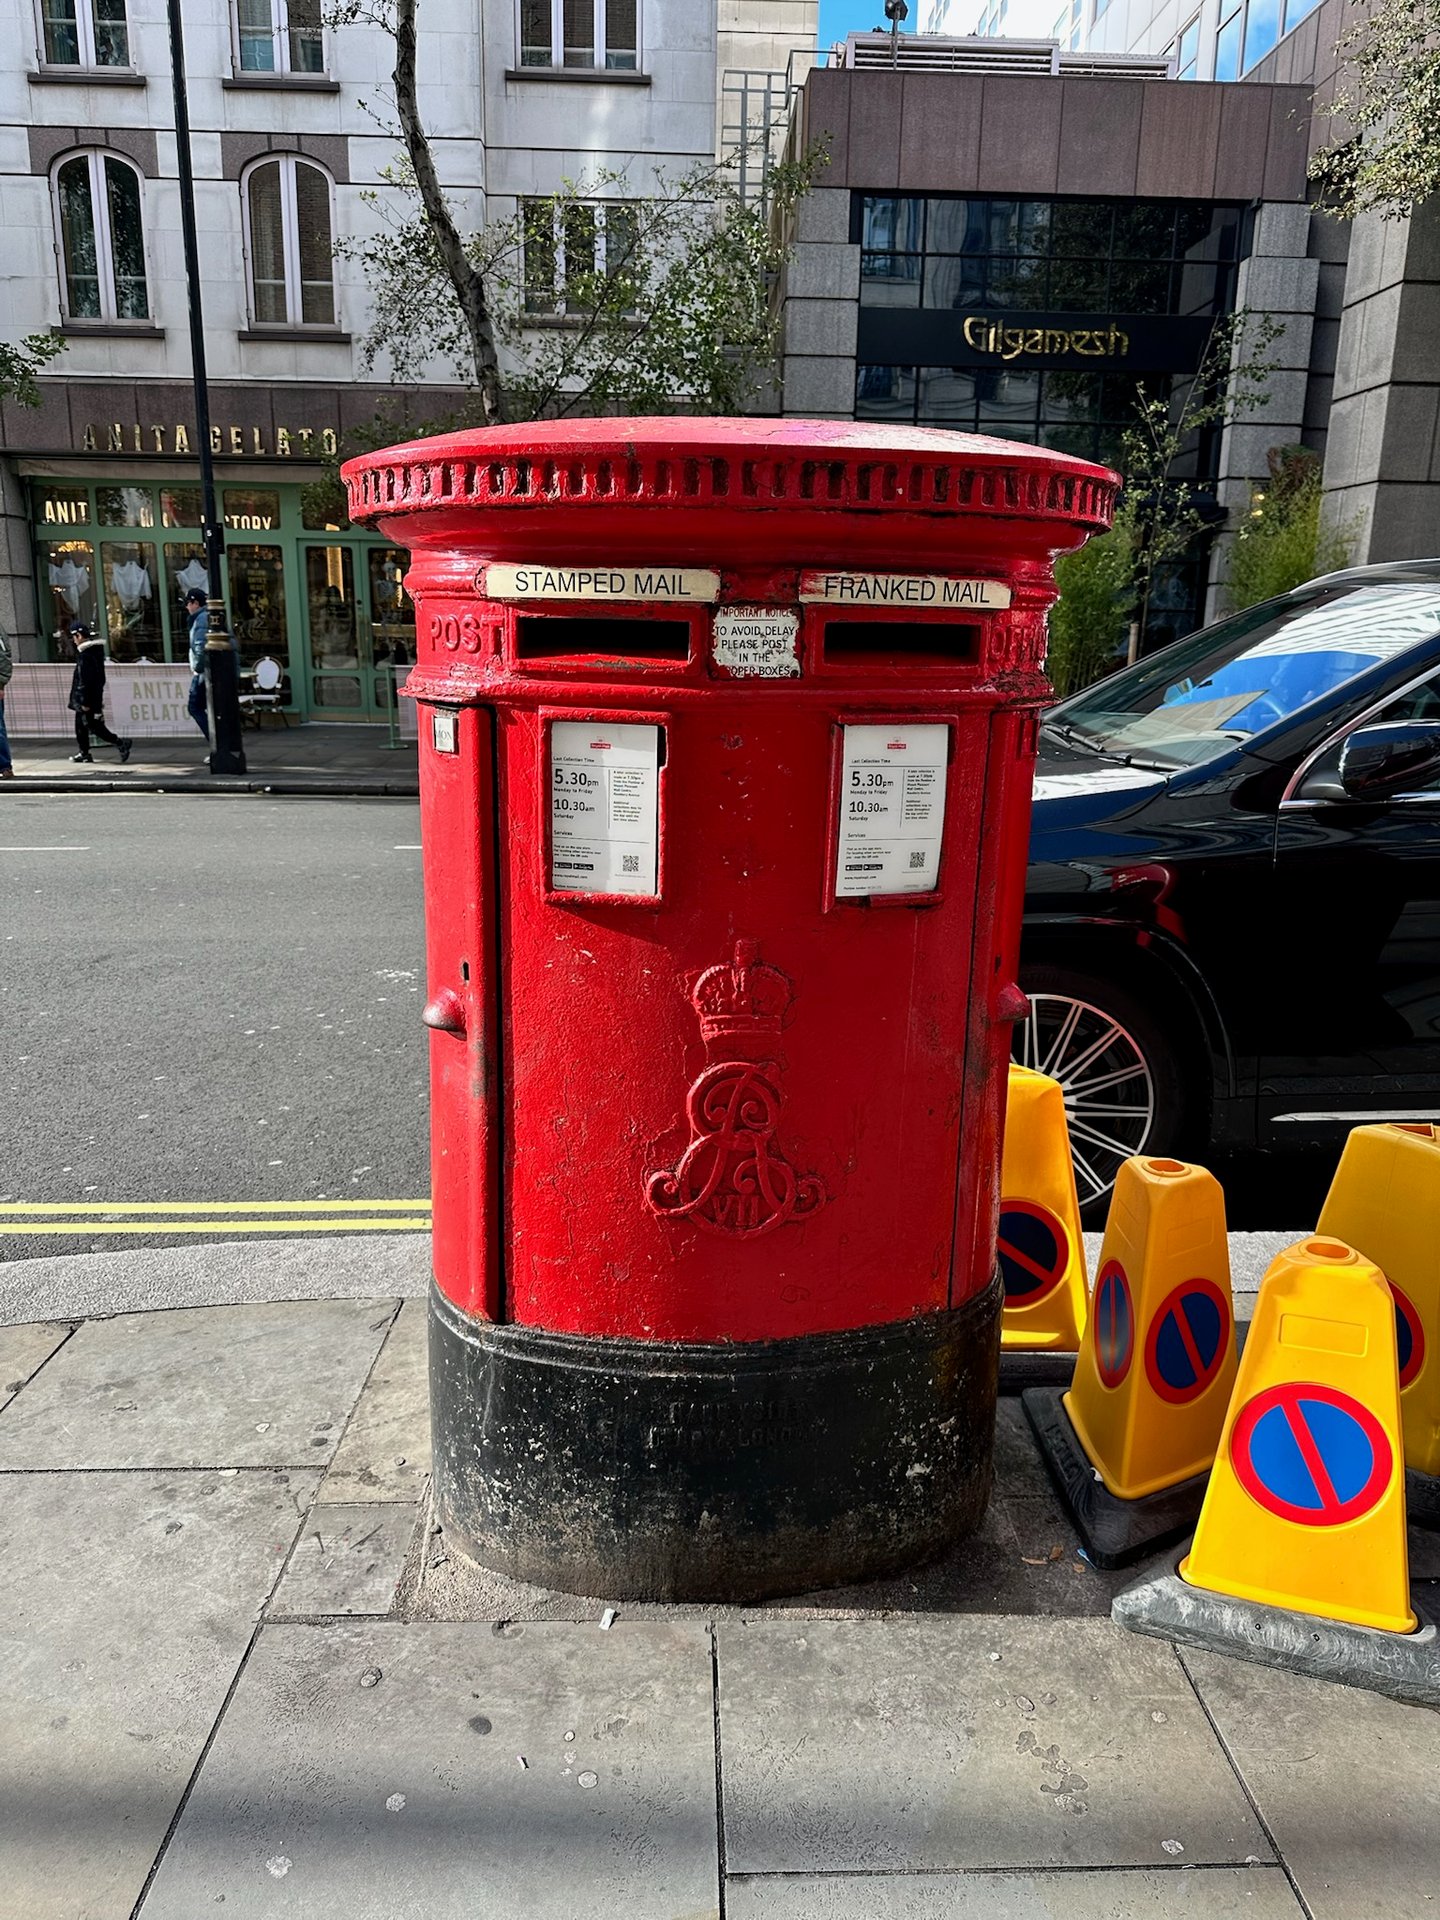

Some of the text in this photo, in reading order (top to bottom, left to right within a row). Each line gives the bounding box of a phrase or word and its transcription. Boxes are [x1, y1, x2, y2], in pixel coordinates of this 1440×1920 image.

[963, 316, 1129, 360] Gilgamesh
[83, 423, 338, 456] ANITA GELATO
[515, 571, 692, 596] STAMPED MAIL
[824, 575, 990, 603] FRANKED MAIL
[431, 613, 503, 656] POST
[716, 625, 795, 636] TO AVOID DELAY
[721, 639, 788, 650] PLEASE POST
[739, 652, 771, 662] IN THE
[728, 665, 791, 676] OPER BOXES
[132, 681, 184, 700] ANITA
[130, 703, 190, 721] GELATO
[554, 768, 599, 787] 5.30pm
[851, 770, 894, 788] 5.30pm
[553, 799, 596, 812] 10.30am
[849, 800, 889, 813] 10.30am
